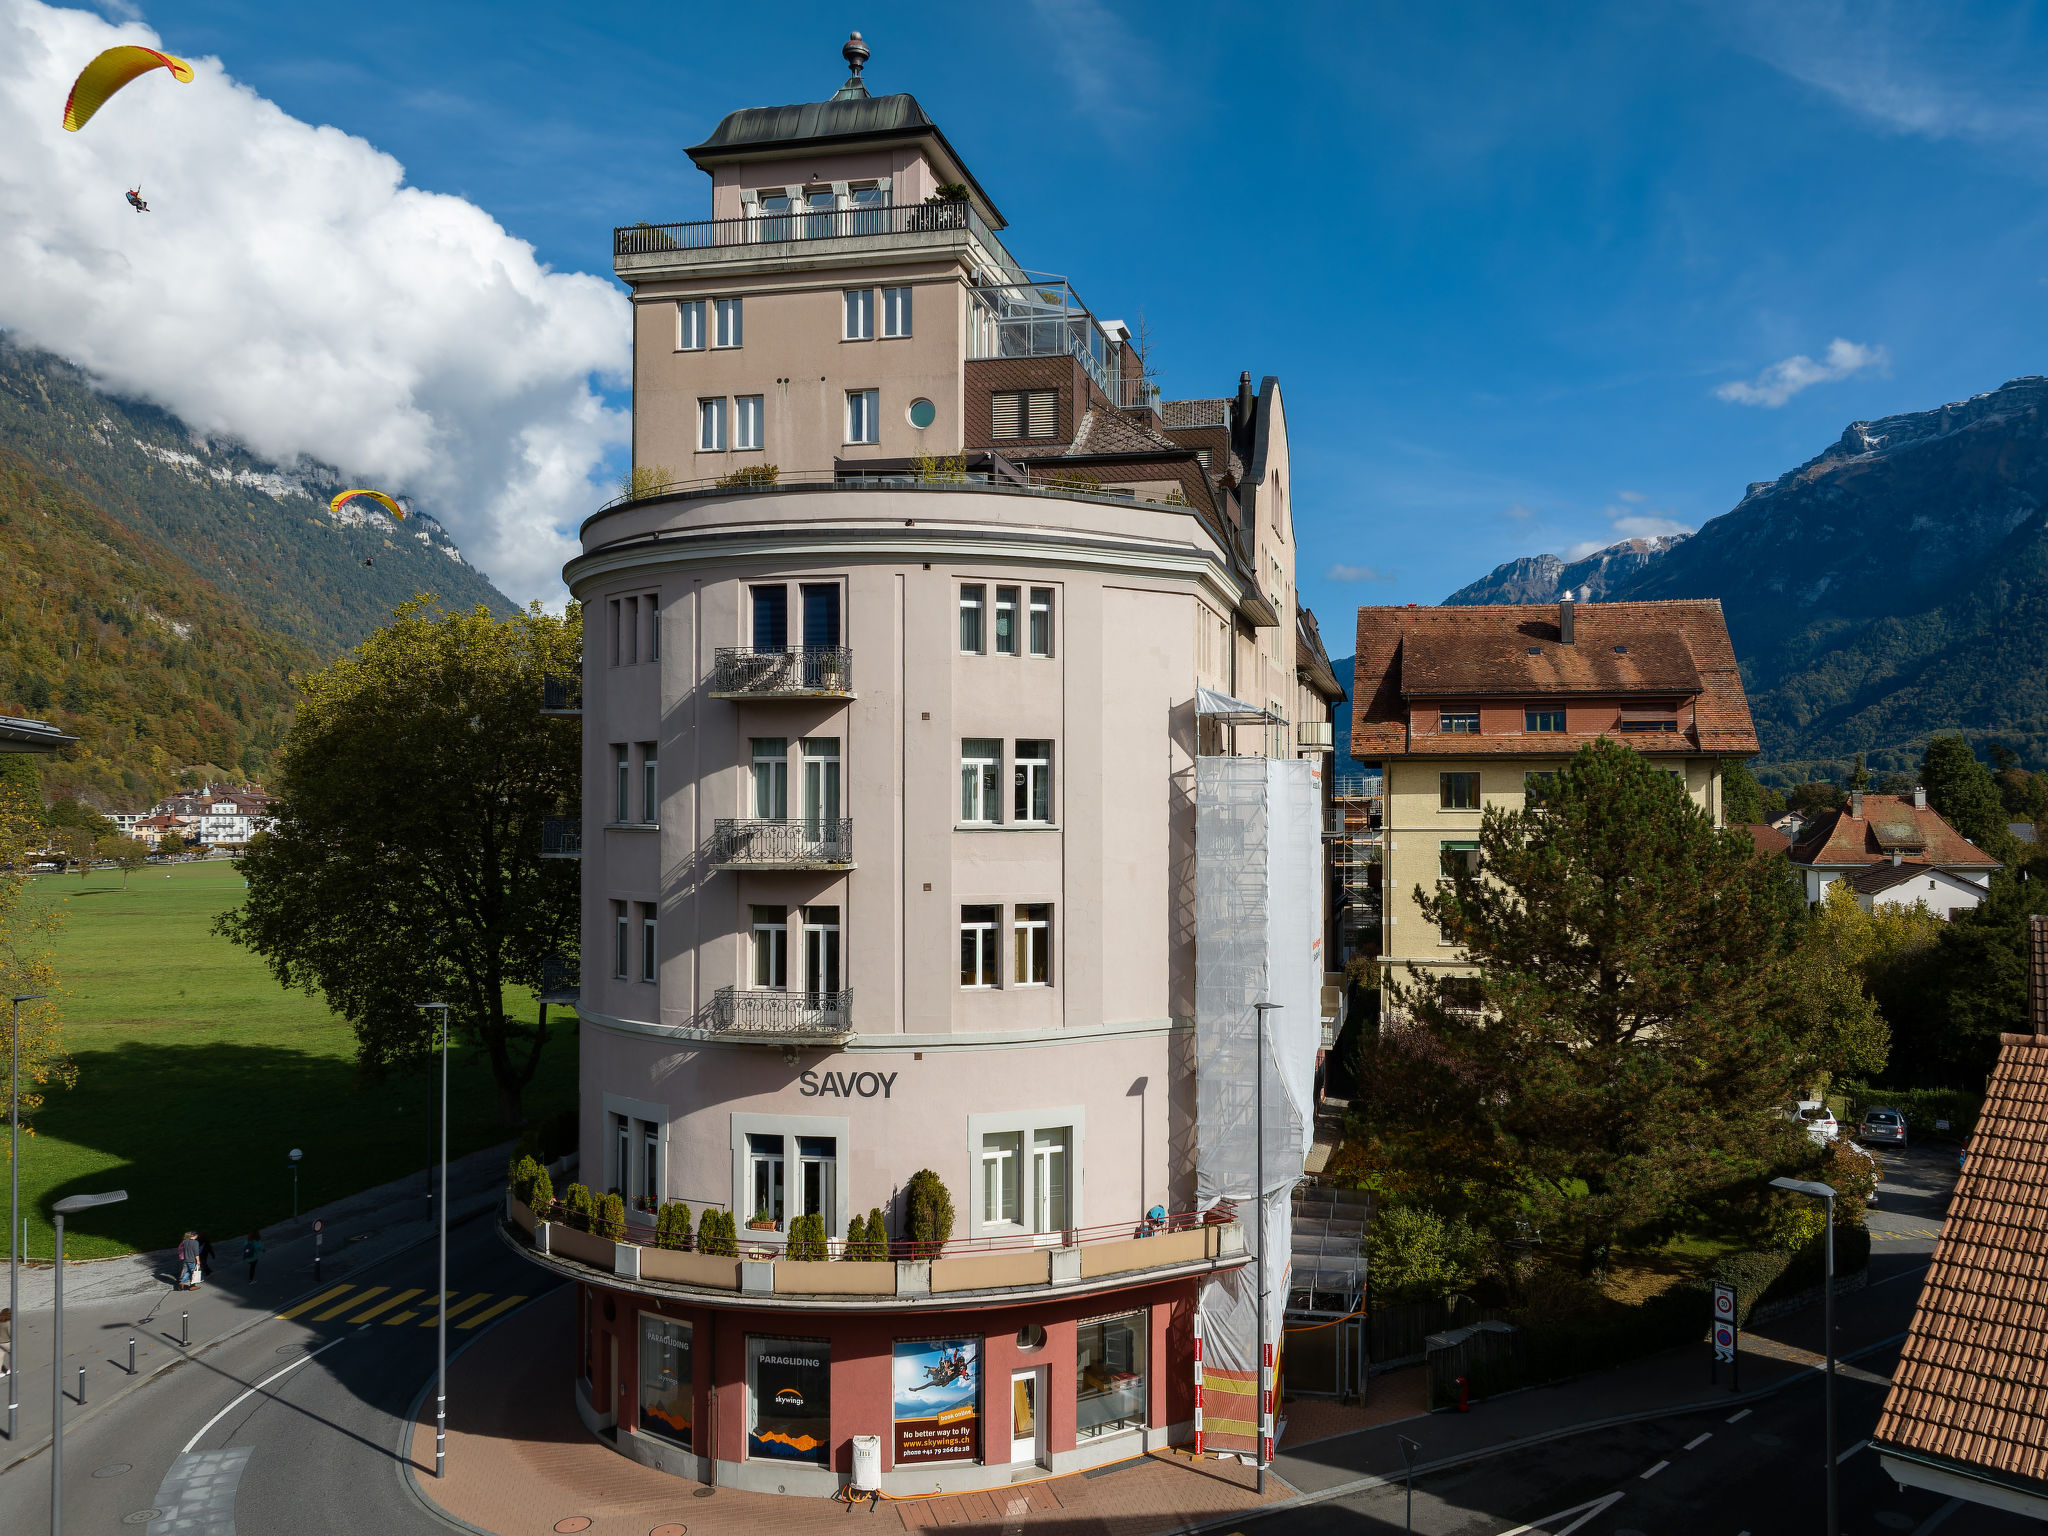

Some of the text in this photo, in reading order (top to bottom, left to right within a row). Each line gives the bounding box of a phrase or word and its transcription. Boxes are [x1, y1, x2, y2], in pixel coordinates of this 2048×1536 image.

[799, 1070, 899, 1099] SAVOY
[1721, 1300, 1728, 1309] 30
[647, 1332, 689, 1350] PARAGLIDING
[759, 1355, 820, 1367] PARAGLIDING
[775, 1395, 804, 1406] skywings
[914, 1429, 936, 1438] better
[936, 1429, 951, 1437] way
[960, 1427, 970, 1435] fly
[903, 1436, 970, 1448] www.skywings.ch
